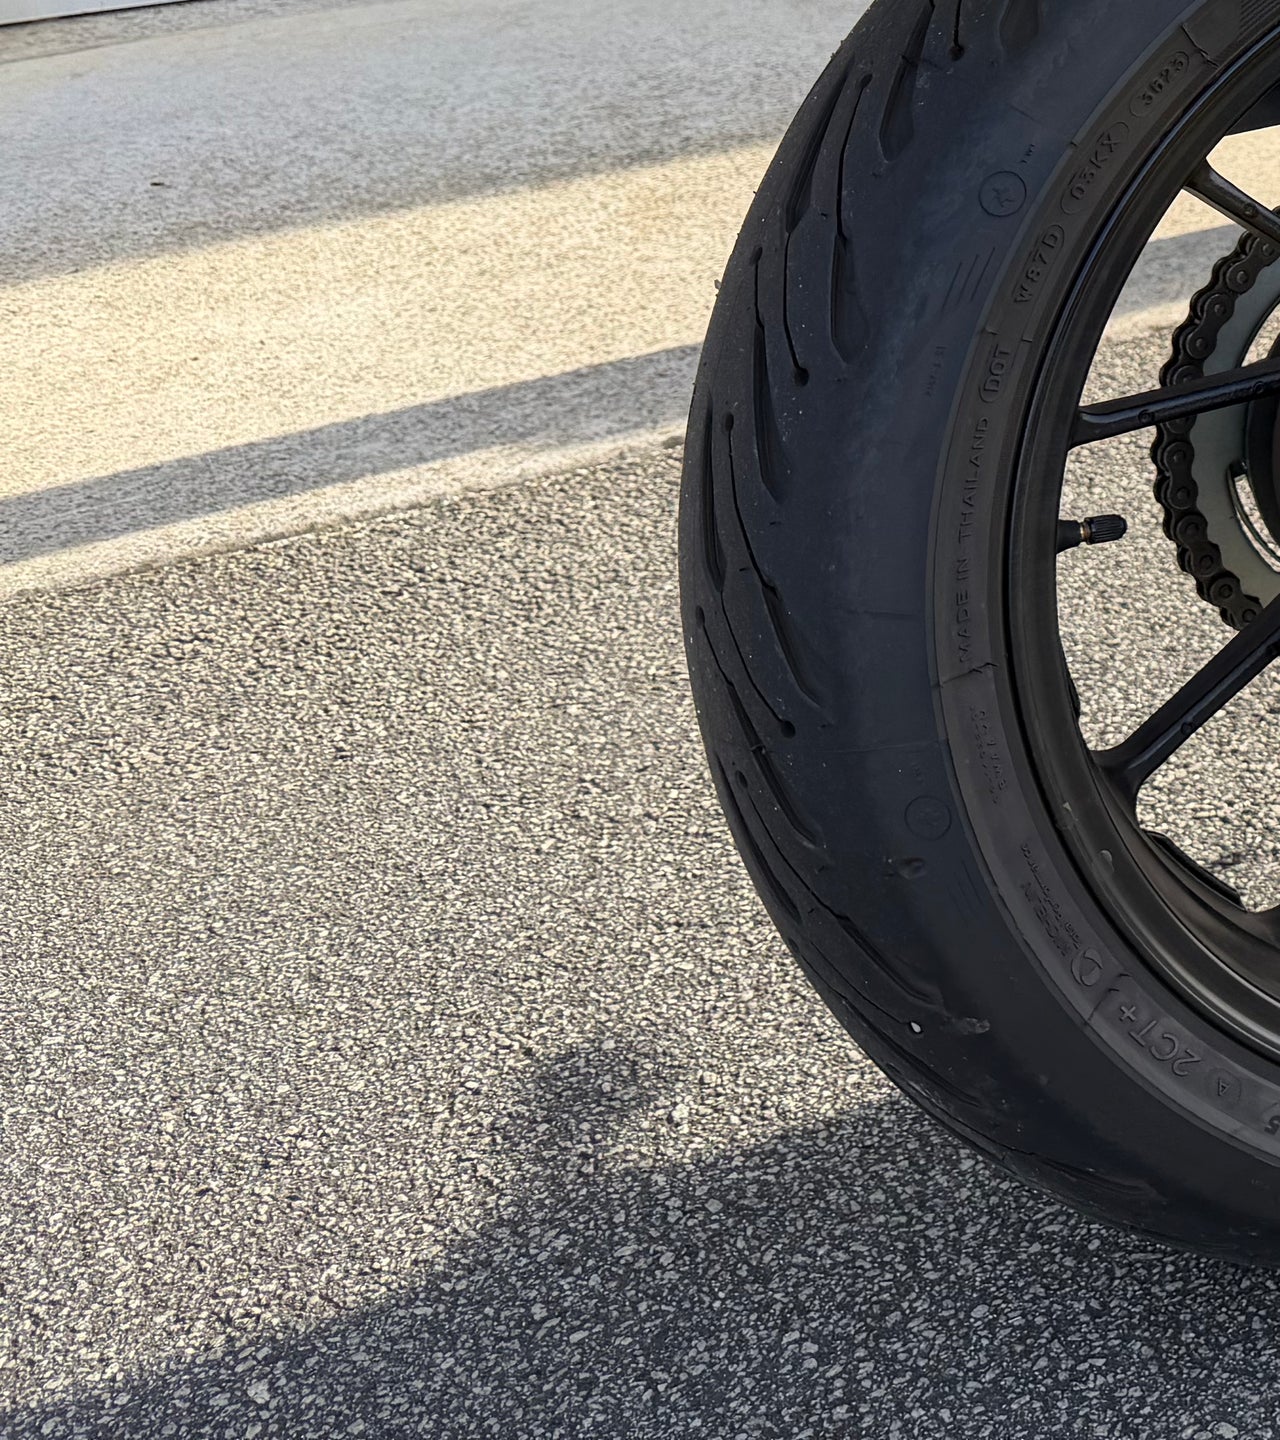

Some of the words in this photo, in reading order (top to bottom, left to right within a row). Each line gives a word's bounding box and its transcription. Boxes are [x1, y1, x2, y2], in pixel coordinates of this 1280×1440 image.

[983, 347, 1012, 394] DOT
[957, 416, 991, 544] THAILAND
[955, 557, 970, 584] IN
[955, 593, 974, 663] MADE
[1117, 1003, 1204, 1077] 2CT+
